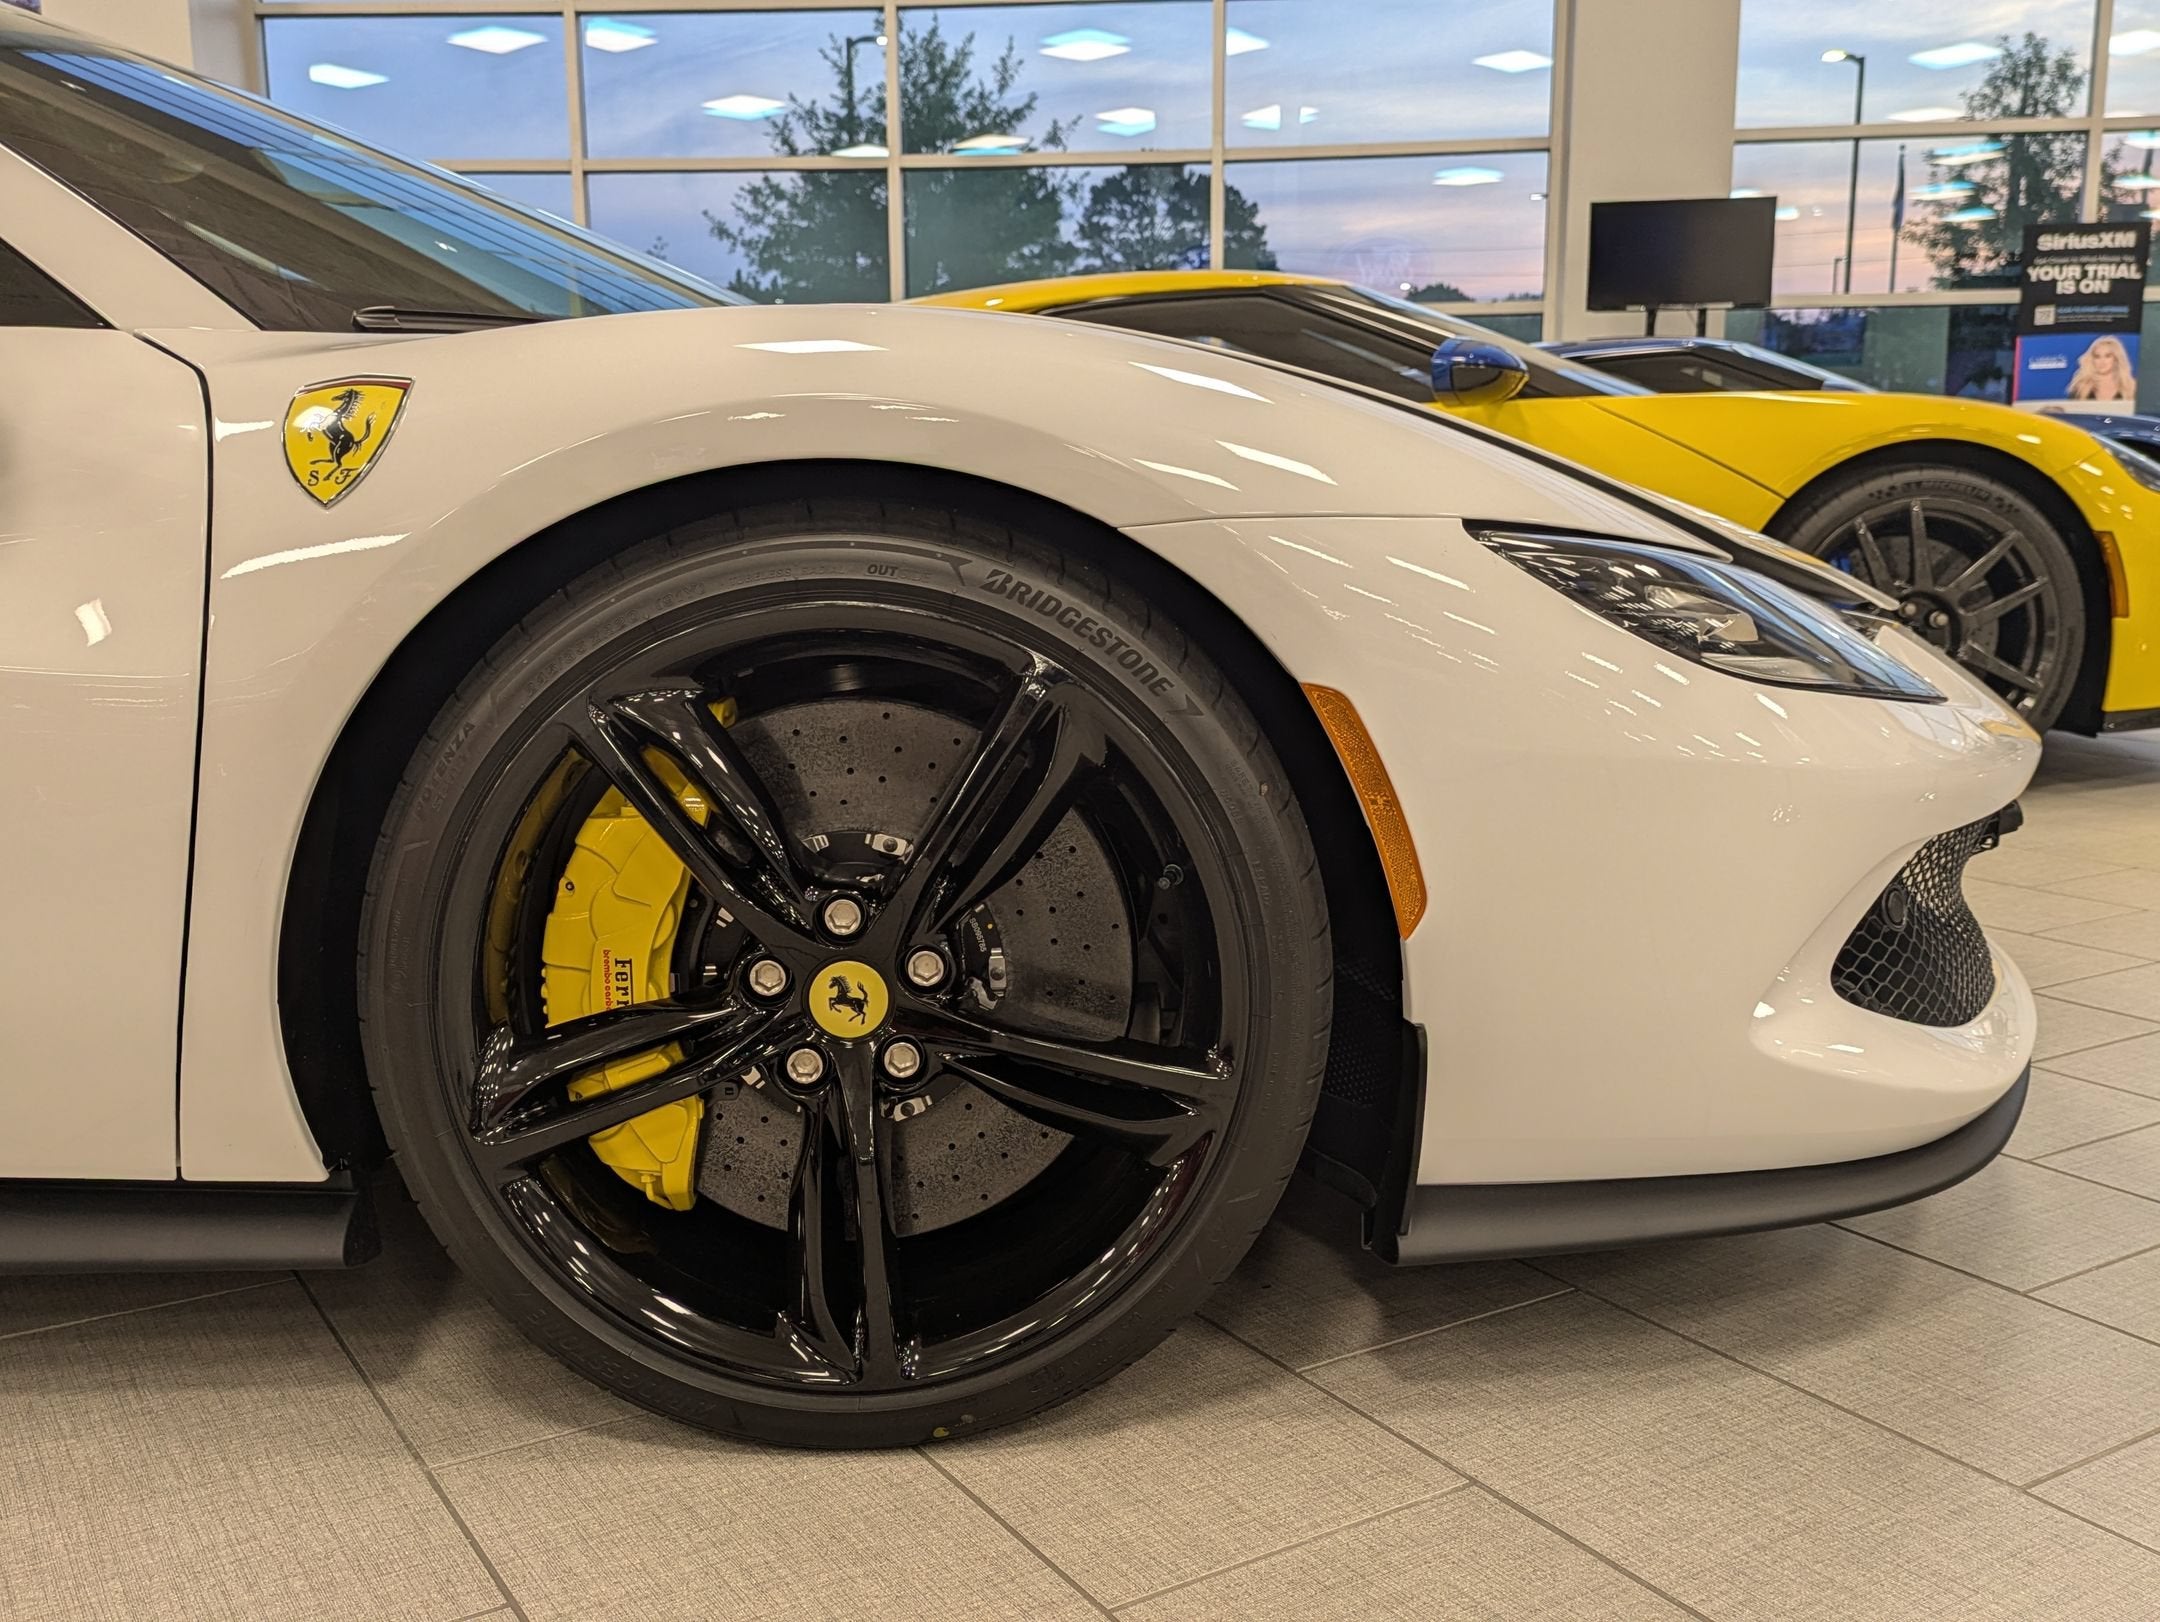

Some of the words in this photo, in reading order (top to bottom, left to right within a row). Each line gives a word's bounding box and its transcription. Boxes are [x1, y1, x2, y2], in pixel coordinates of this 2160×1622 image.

[2037, 230, 2137, 251] SiriusXM
[2026, 264, 2081, 282] YOUR
[2084, 263, 2143, 280] TRIAL
[2056, 279, 2076, 295] IS
[2079, 278, 2110, 294] ON
[307, 470, 320, 486] S
[334, 467, 360, 486] F
[979, 568, 1175, 697] BRIDGESTONE
[603, 949, 612, 985] brembo
